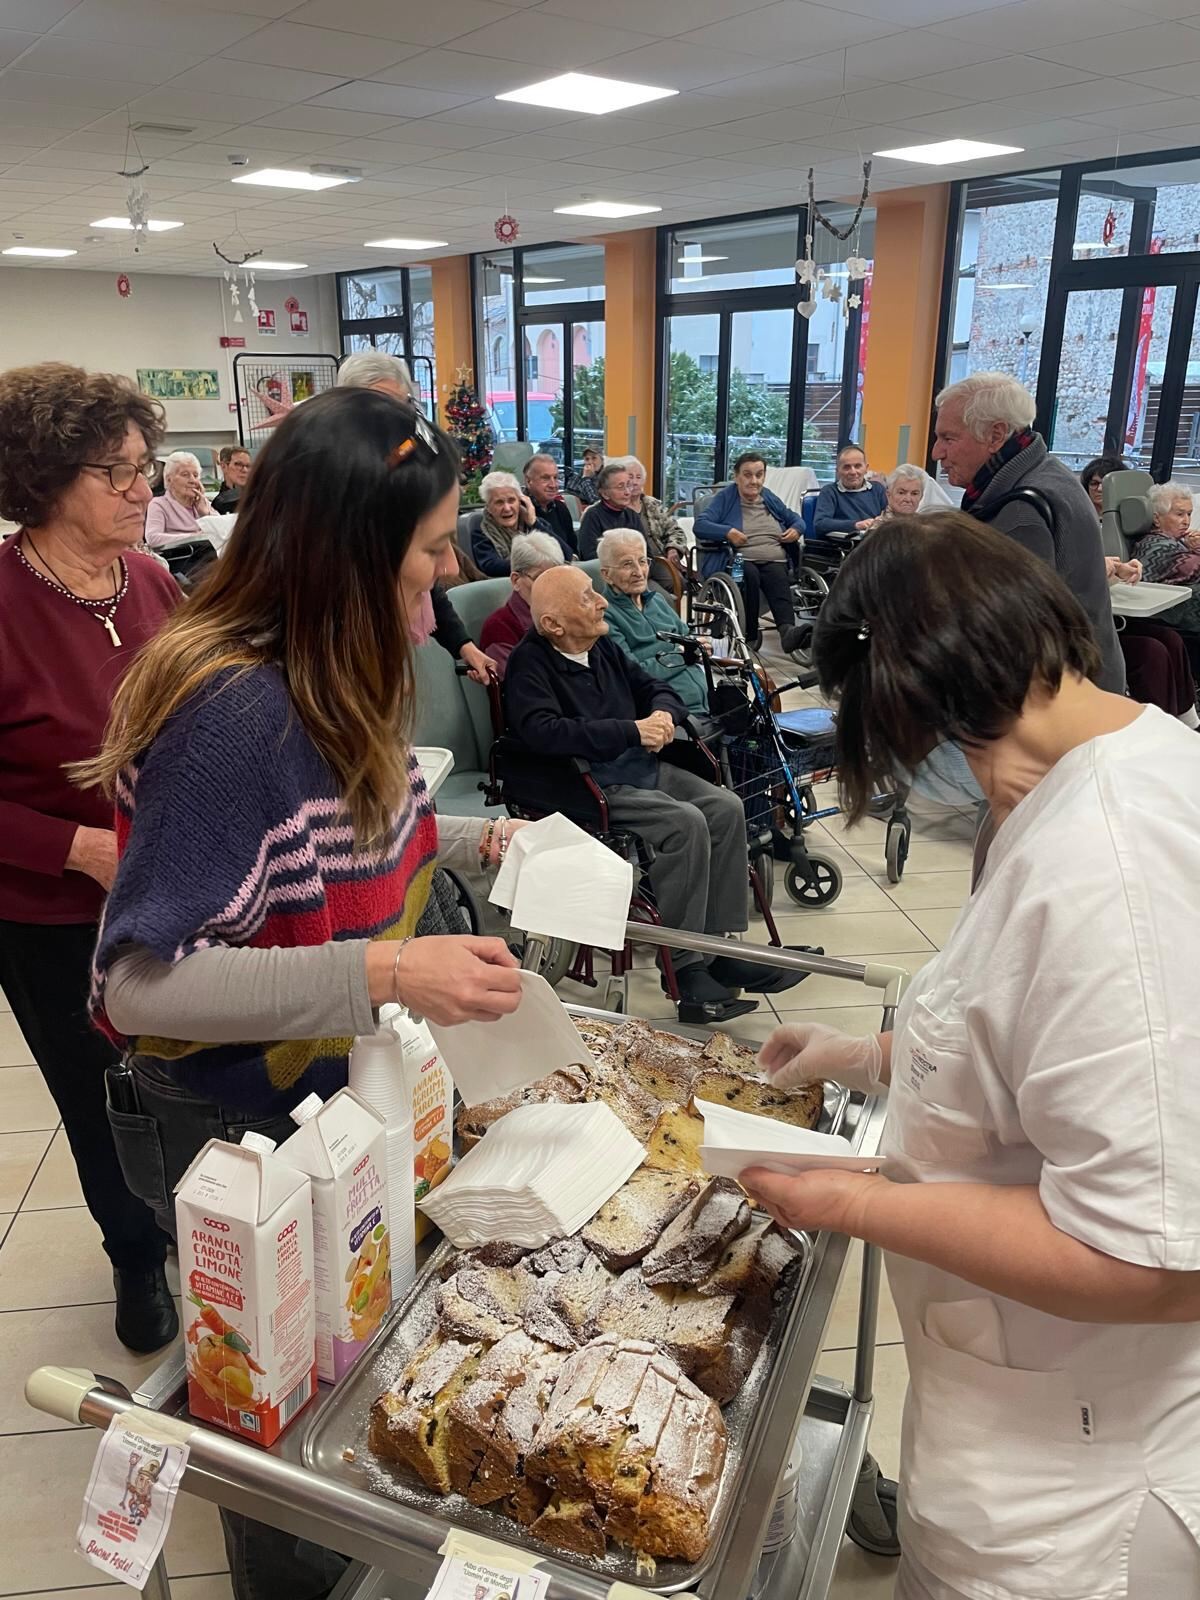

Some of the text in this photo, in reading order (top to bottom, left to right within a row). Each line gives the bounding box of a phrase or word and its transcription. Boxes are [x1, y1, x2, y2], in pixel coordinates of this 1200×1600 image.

[413, 1088, 445, 1120] CAROTA
[353, 1154, 369, 1176] coop
[346, 1173, 380, 1219] FRUTTA
[348, 1164, 376, 1202] MULTI
[203, 1217, 230, 1232] coop
[277, 1220, 297, 1242] coop
[191, 1230, 243, 1259] ARANCIA,
[193, 1243, 243, 1271] CAROTA,
[195, 1255, 242, 1283] LIMONE
[464, 1561, 513, 1585] Albo d'Onore degli
